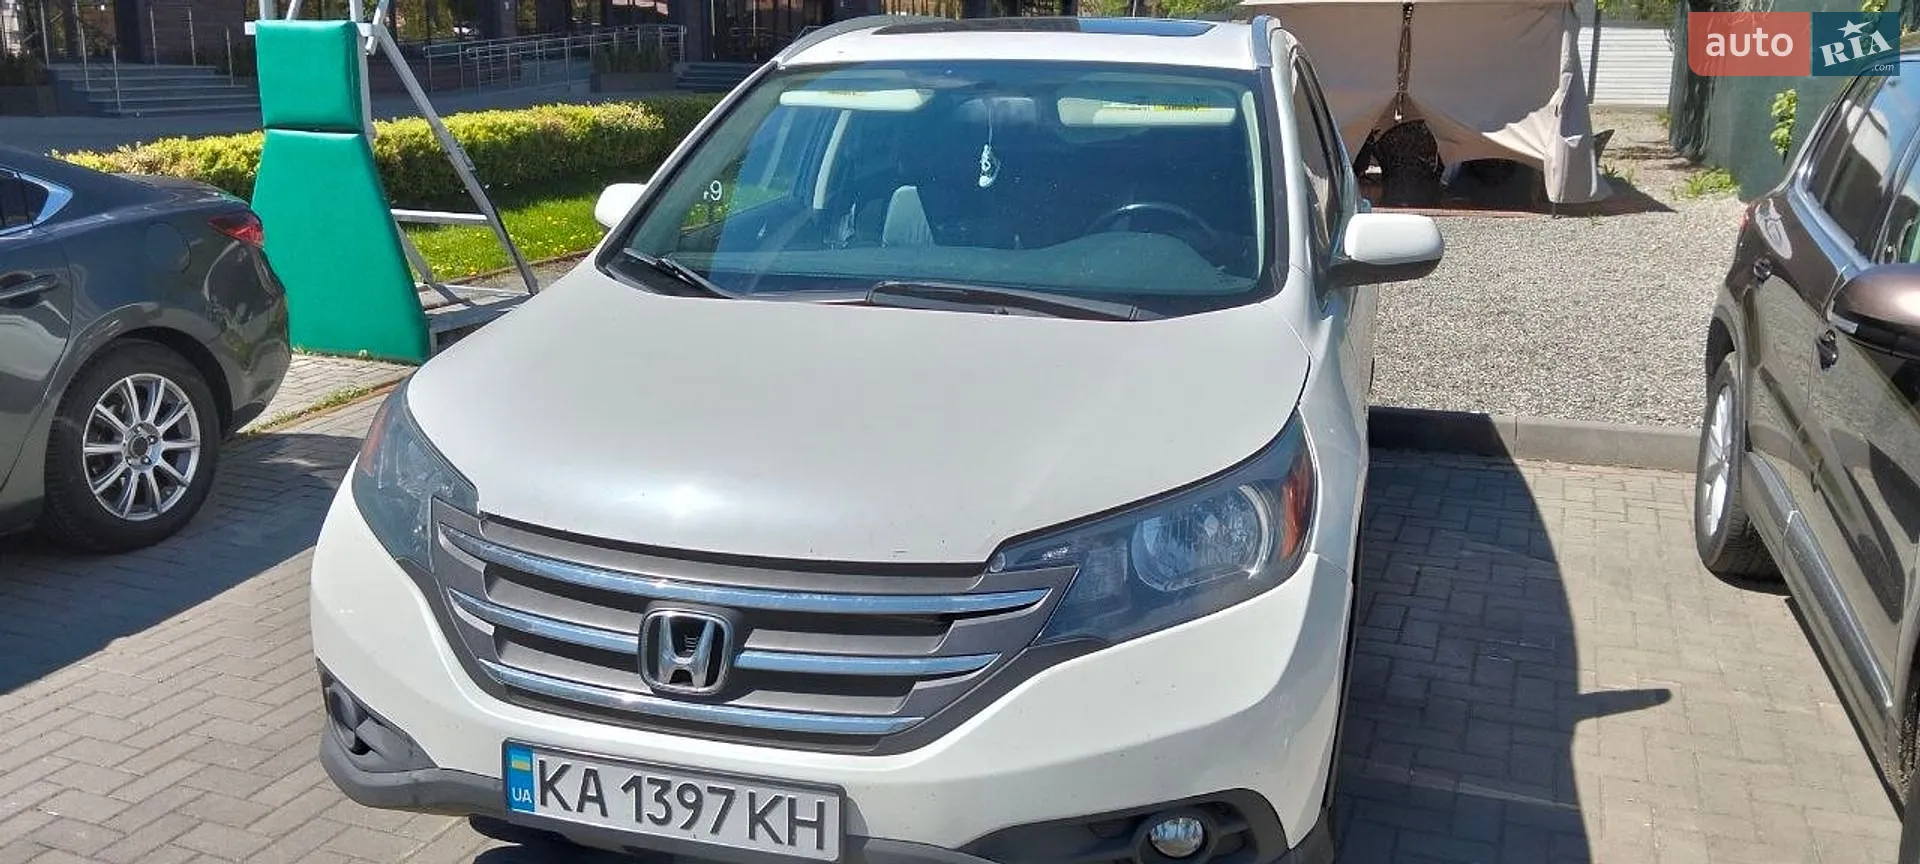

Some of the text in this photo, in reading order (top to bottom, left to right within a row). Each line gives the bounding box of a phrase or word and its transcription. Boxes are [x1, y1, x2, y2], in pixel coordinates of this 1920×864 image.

[512, 787, 532, 803] UA
[539, 759, 825, 850] KA 1397 KH
